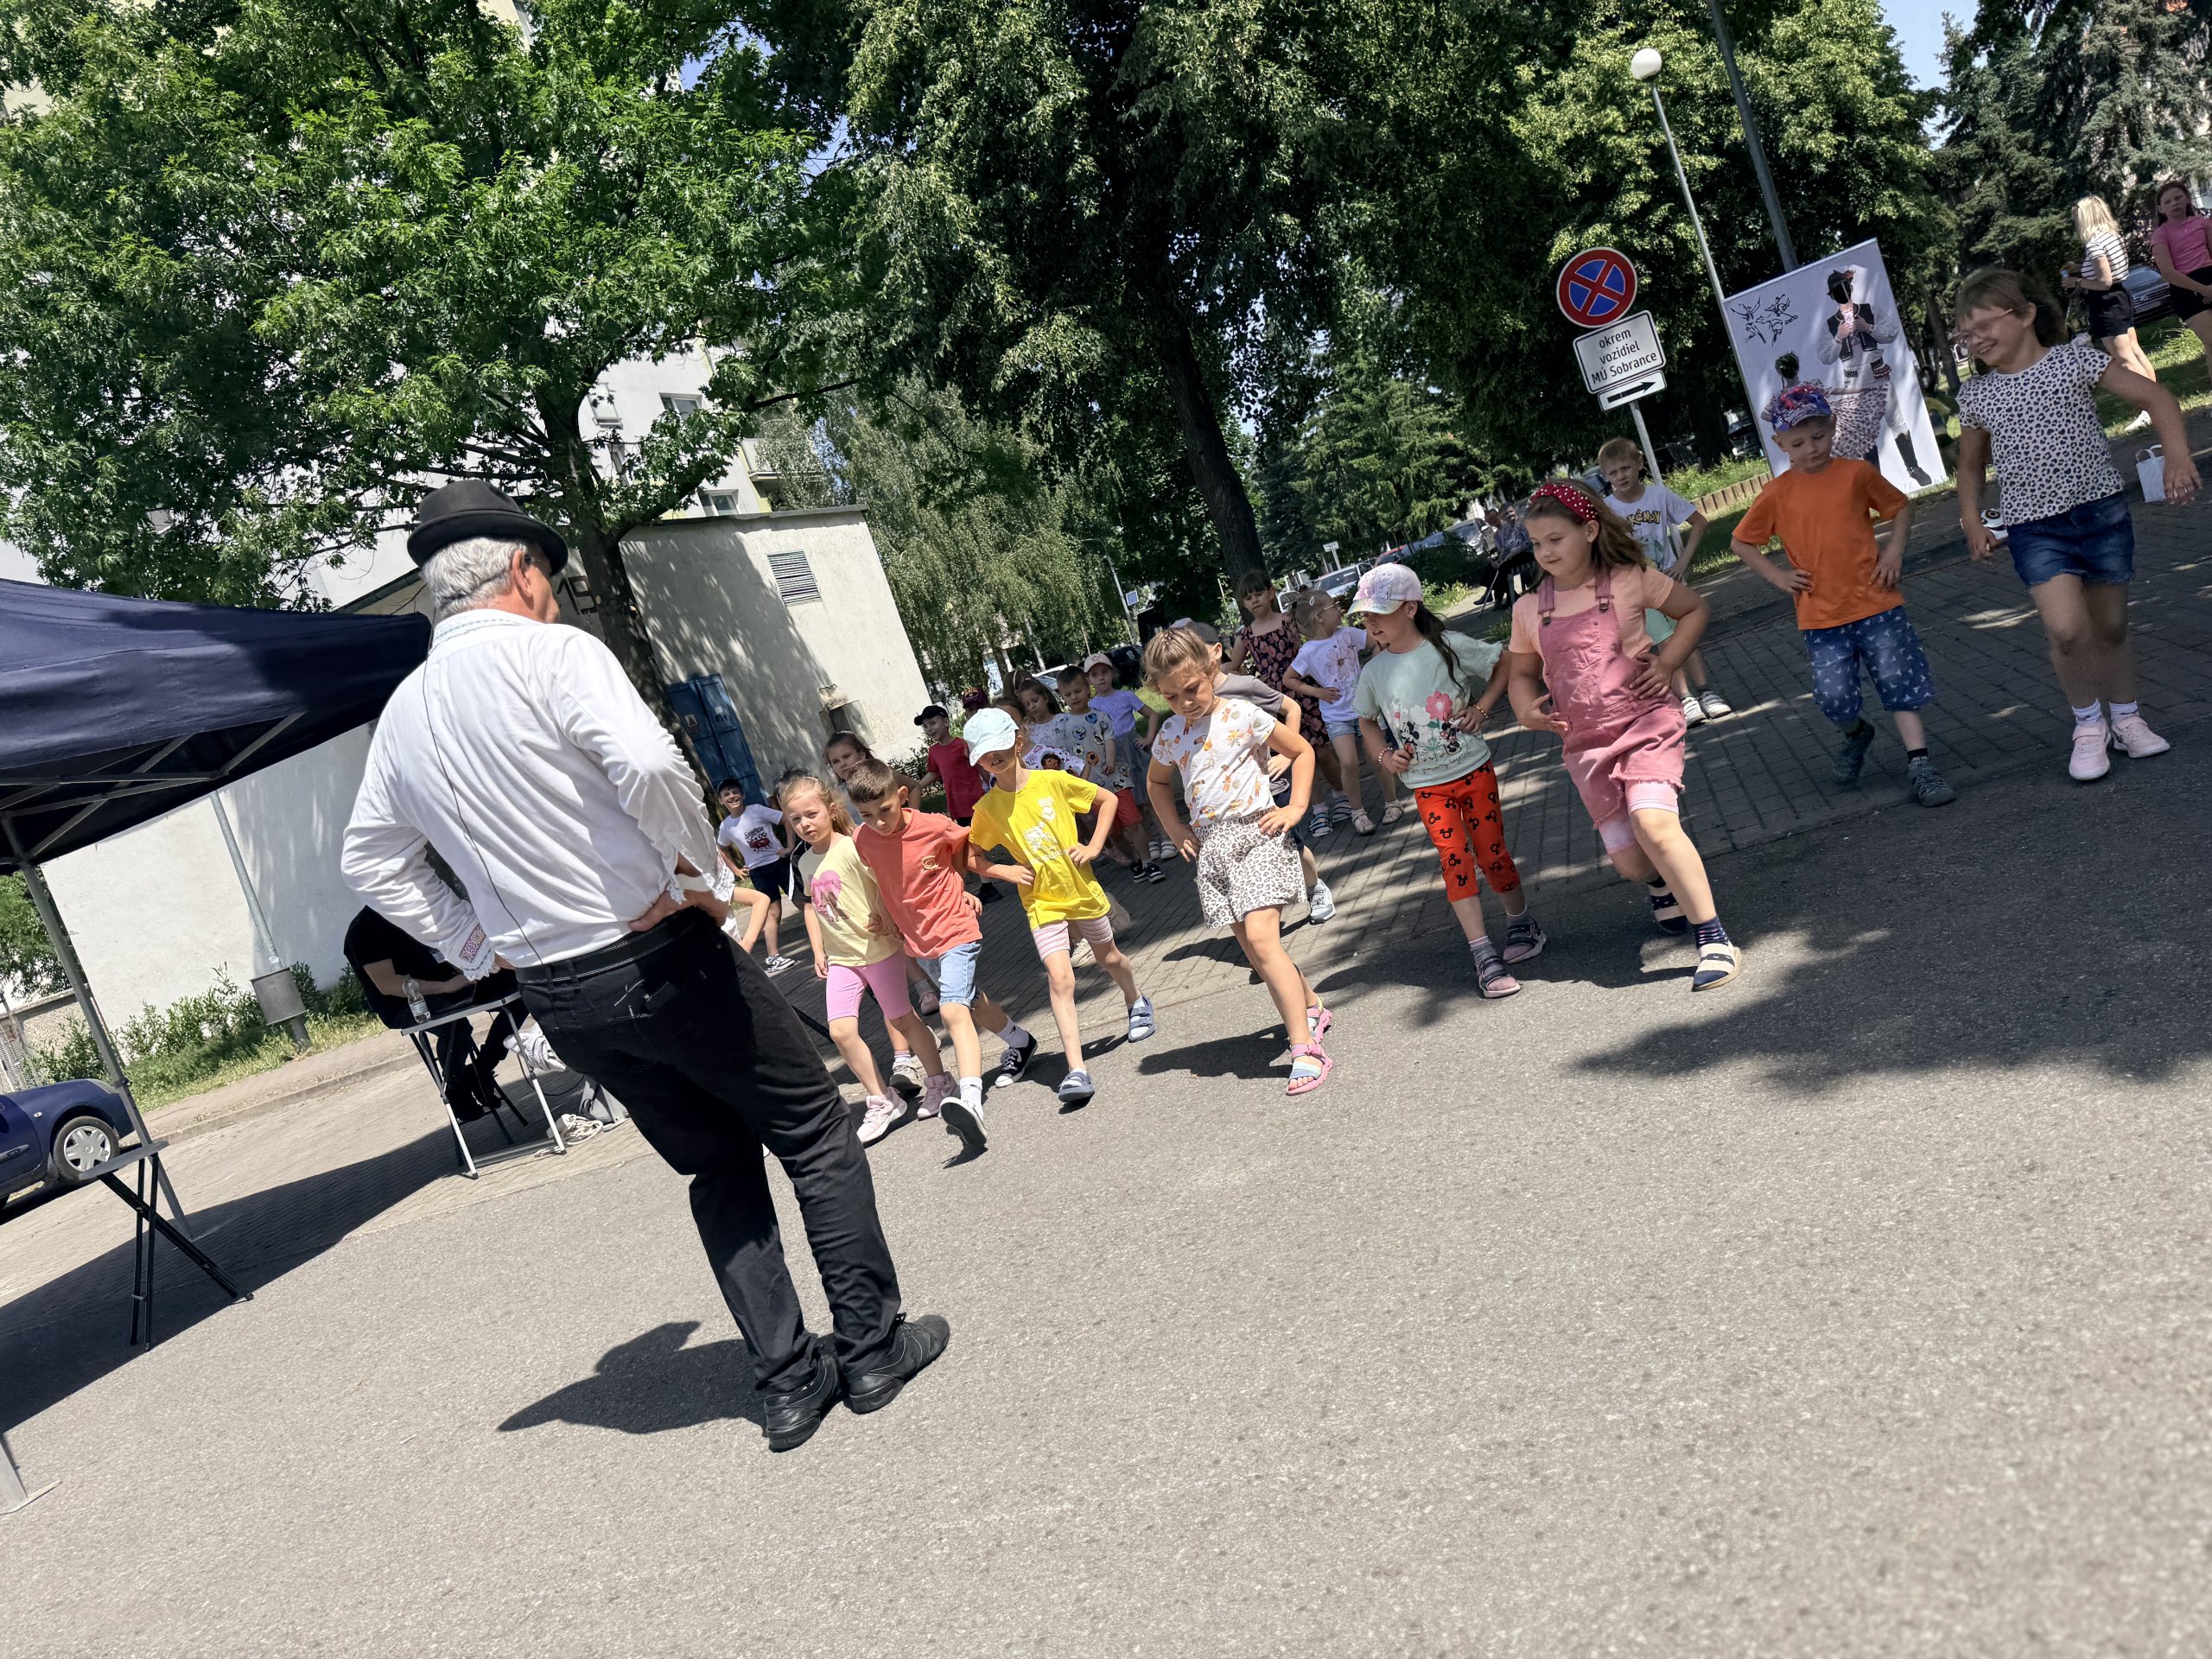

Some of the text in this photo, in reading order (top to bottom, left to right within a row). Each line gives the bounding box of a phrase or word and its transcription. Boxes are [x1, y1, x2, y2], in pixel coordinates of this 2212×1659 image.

[1599, 329, 1631, 348] okrem
[1599, 341, 1640, 365] vozidiel
[1592, 353, 1657, 384] MÚ Sobrance
